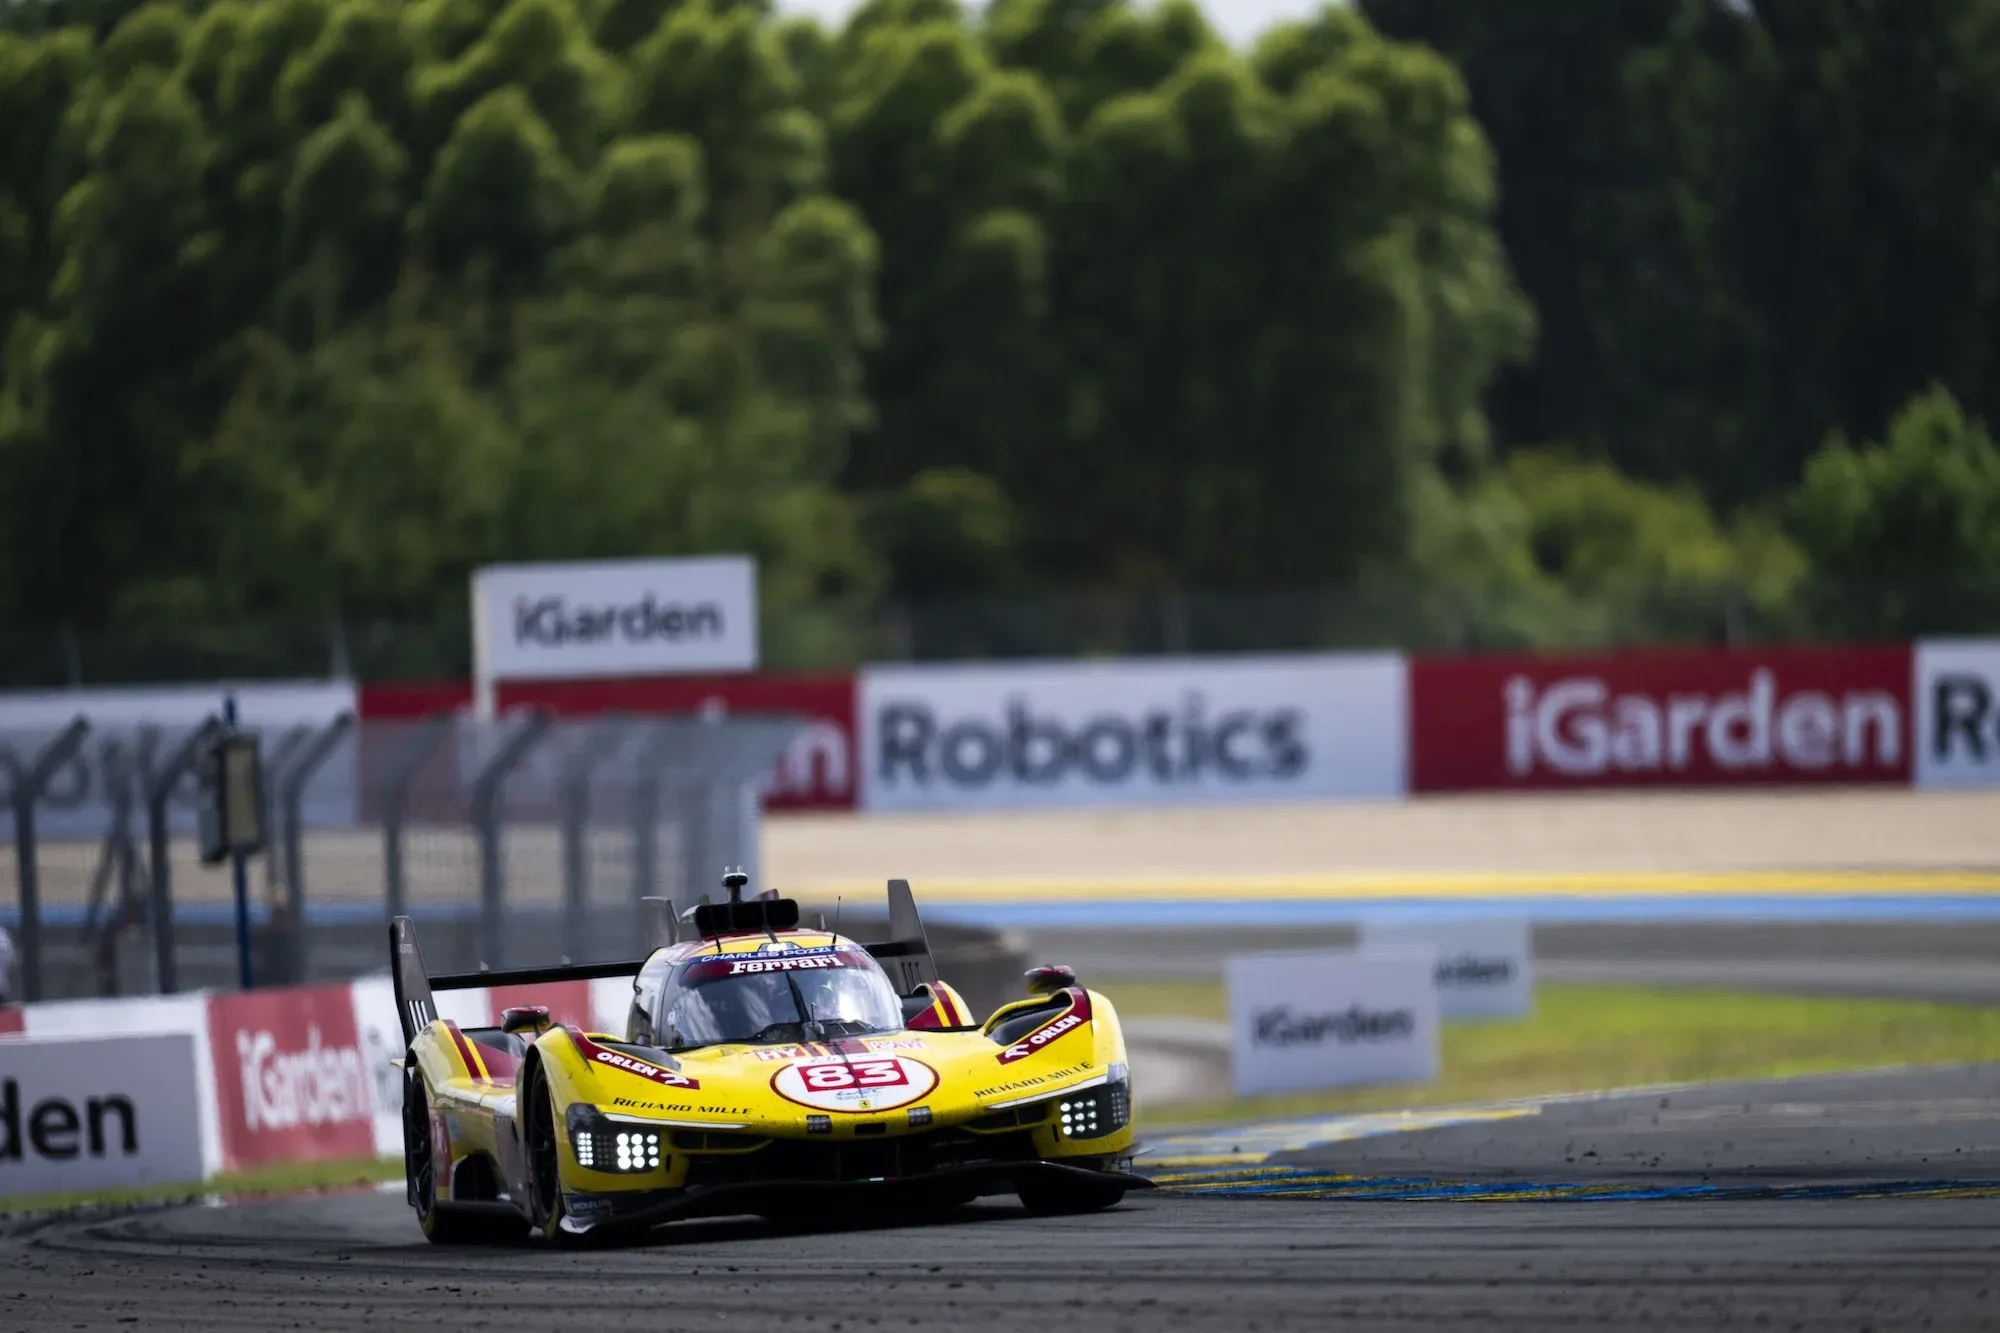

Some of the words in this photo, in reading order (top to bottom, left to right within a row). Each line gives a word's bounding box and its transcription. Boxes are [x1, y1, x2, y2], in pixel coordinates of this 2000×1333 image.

[514, 590, 724, 648] iGarden
[1505, 667, 1899, 775] iGarden
[880, 692, 1309, 786] Robotics
[701, 950, 779, 963] CHARLES
[783, 946, 831, 957] POZZI
[729, 954, 844, 975] Ferrari
[1030, 1015, 1082, 1044] ORLEN
[1254, 1004, 1412, 1047] iGarden
[237, 1022, 371, 1132] iGarden
[597, 1052, 658, 1077] ORLEN
[806, 1061, 901, 1088] 83
[974, 1077, 1045, 1098] RICHARD
[1047, 1061, 1094, 1080] MILLE
[613, 1097, 692, 1112] RICHARD
[698, 1106, 753, 1115] MILLE
